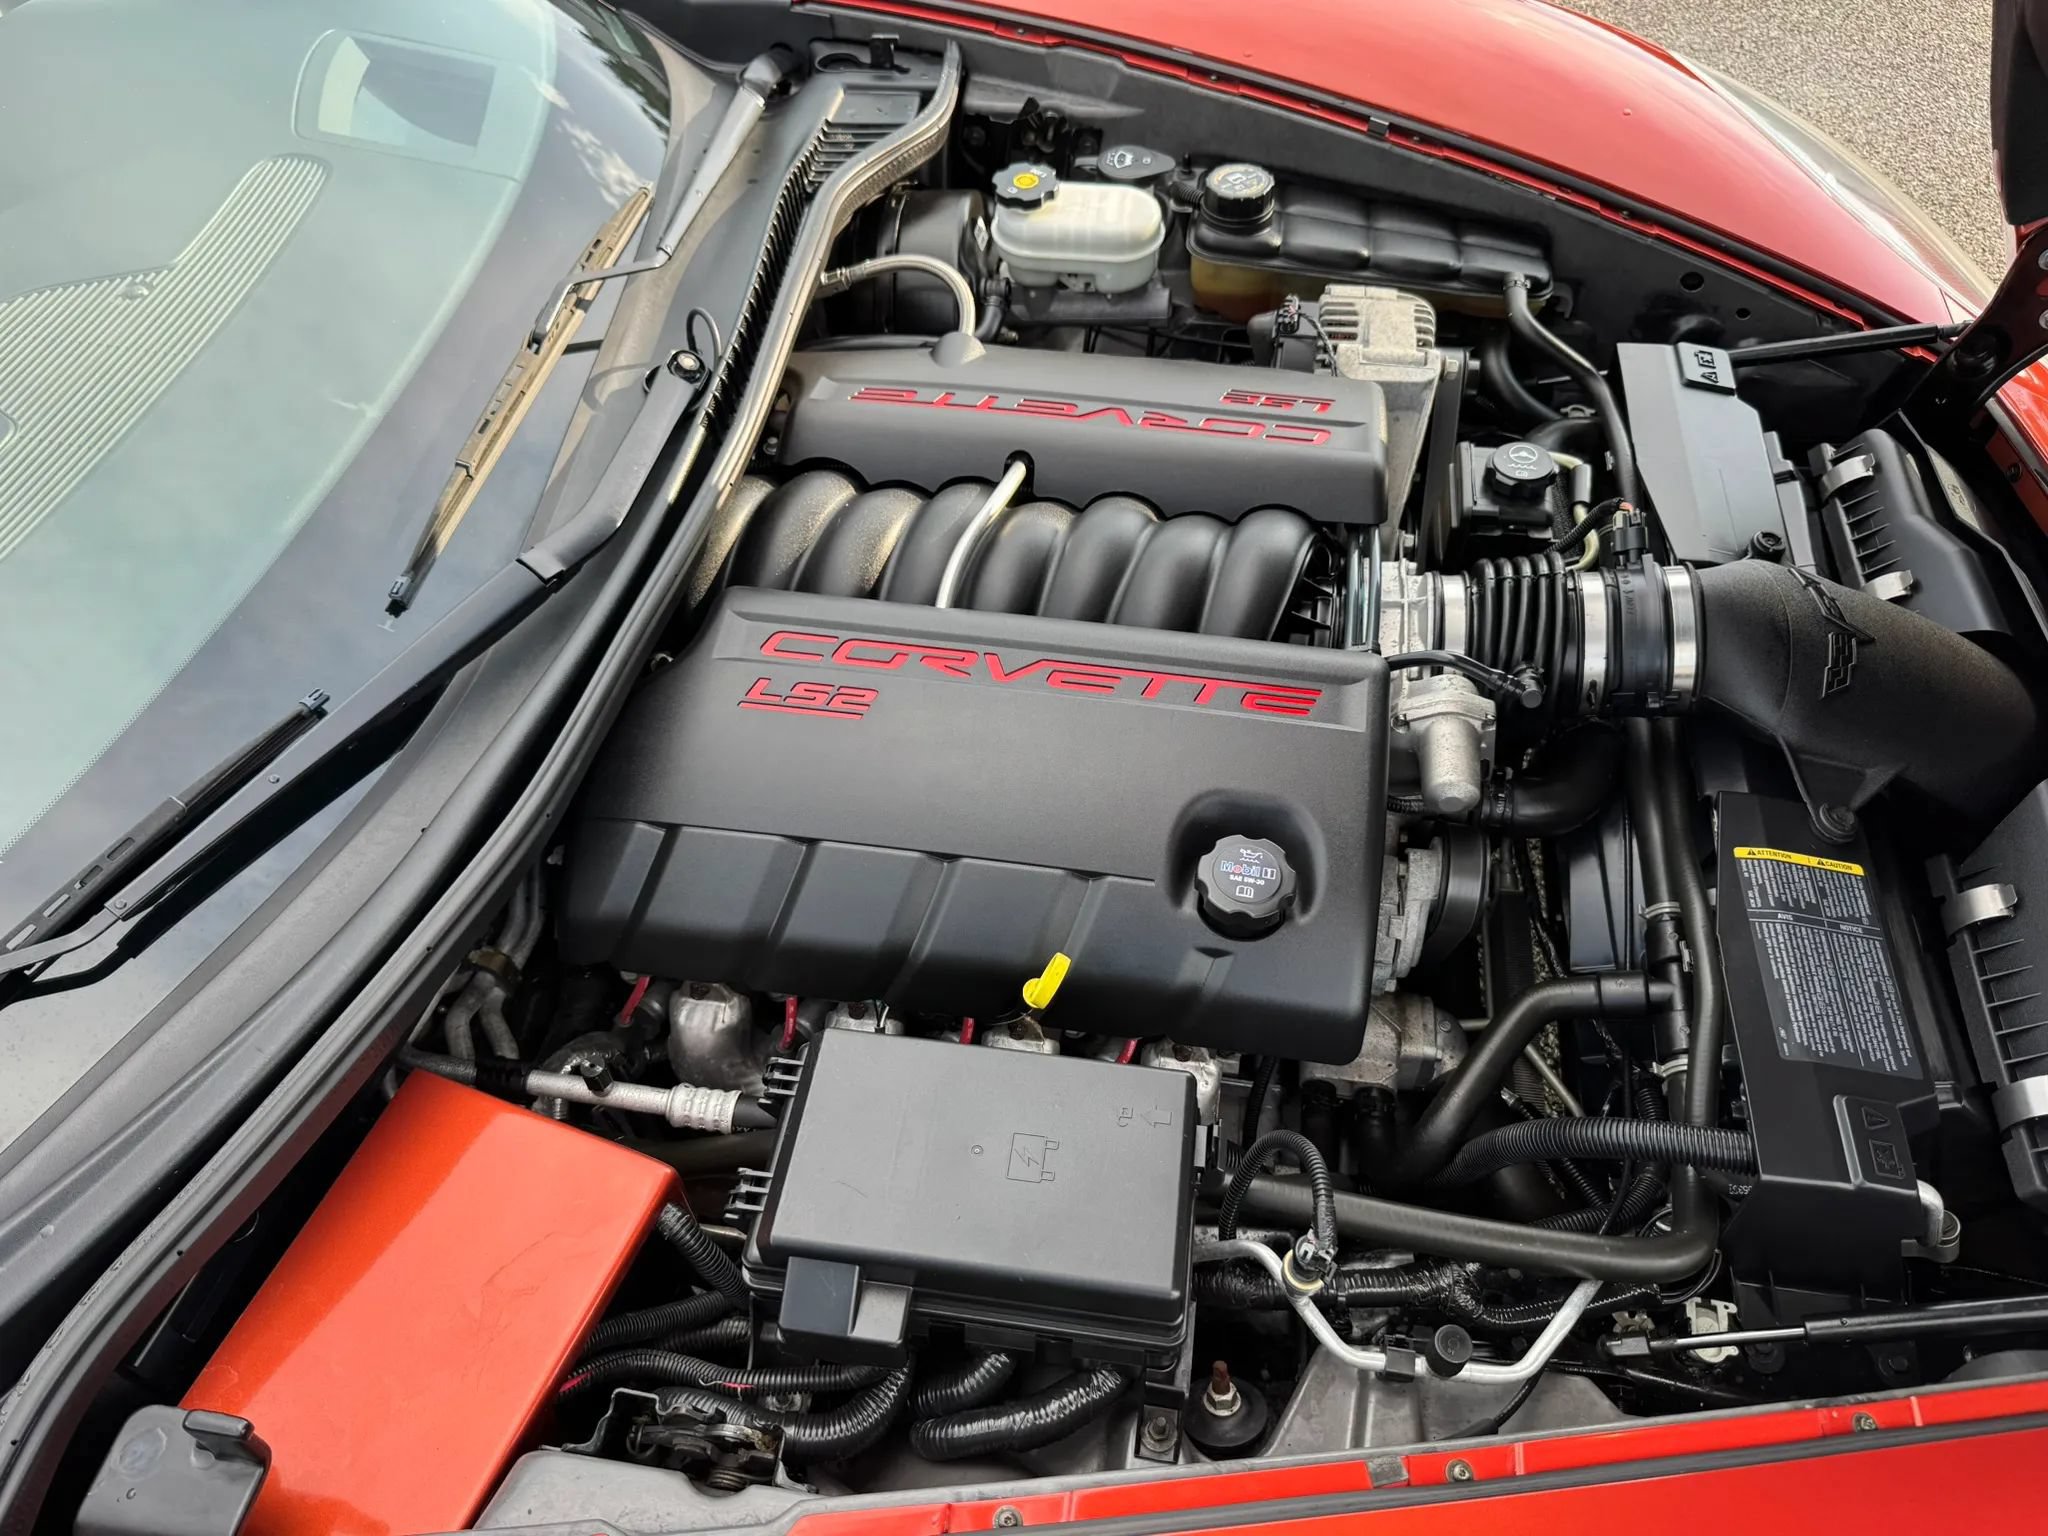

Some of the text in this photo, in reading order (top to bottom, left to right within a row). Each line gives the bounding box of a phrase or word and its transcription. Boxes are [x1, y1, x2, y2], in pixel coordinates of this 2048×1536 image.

[848, 386, 1332, 446] CORVETTE
[759, 630, 1323, 717] CORVETTE
[741, 677, 880, 718] LS2
[1757, 850, 1792, 860] ATTENTION
[1221, 860, 1261, 878] Mobil
[1825, 861, 1853, 871] CAUTION
[1840, 924, 1864, 934] NOTICE
